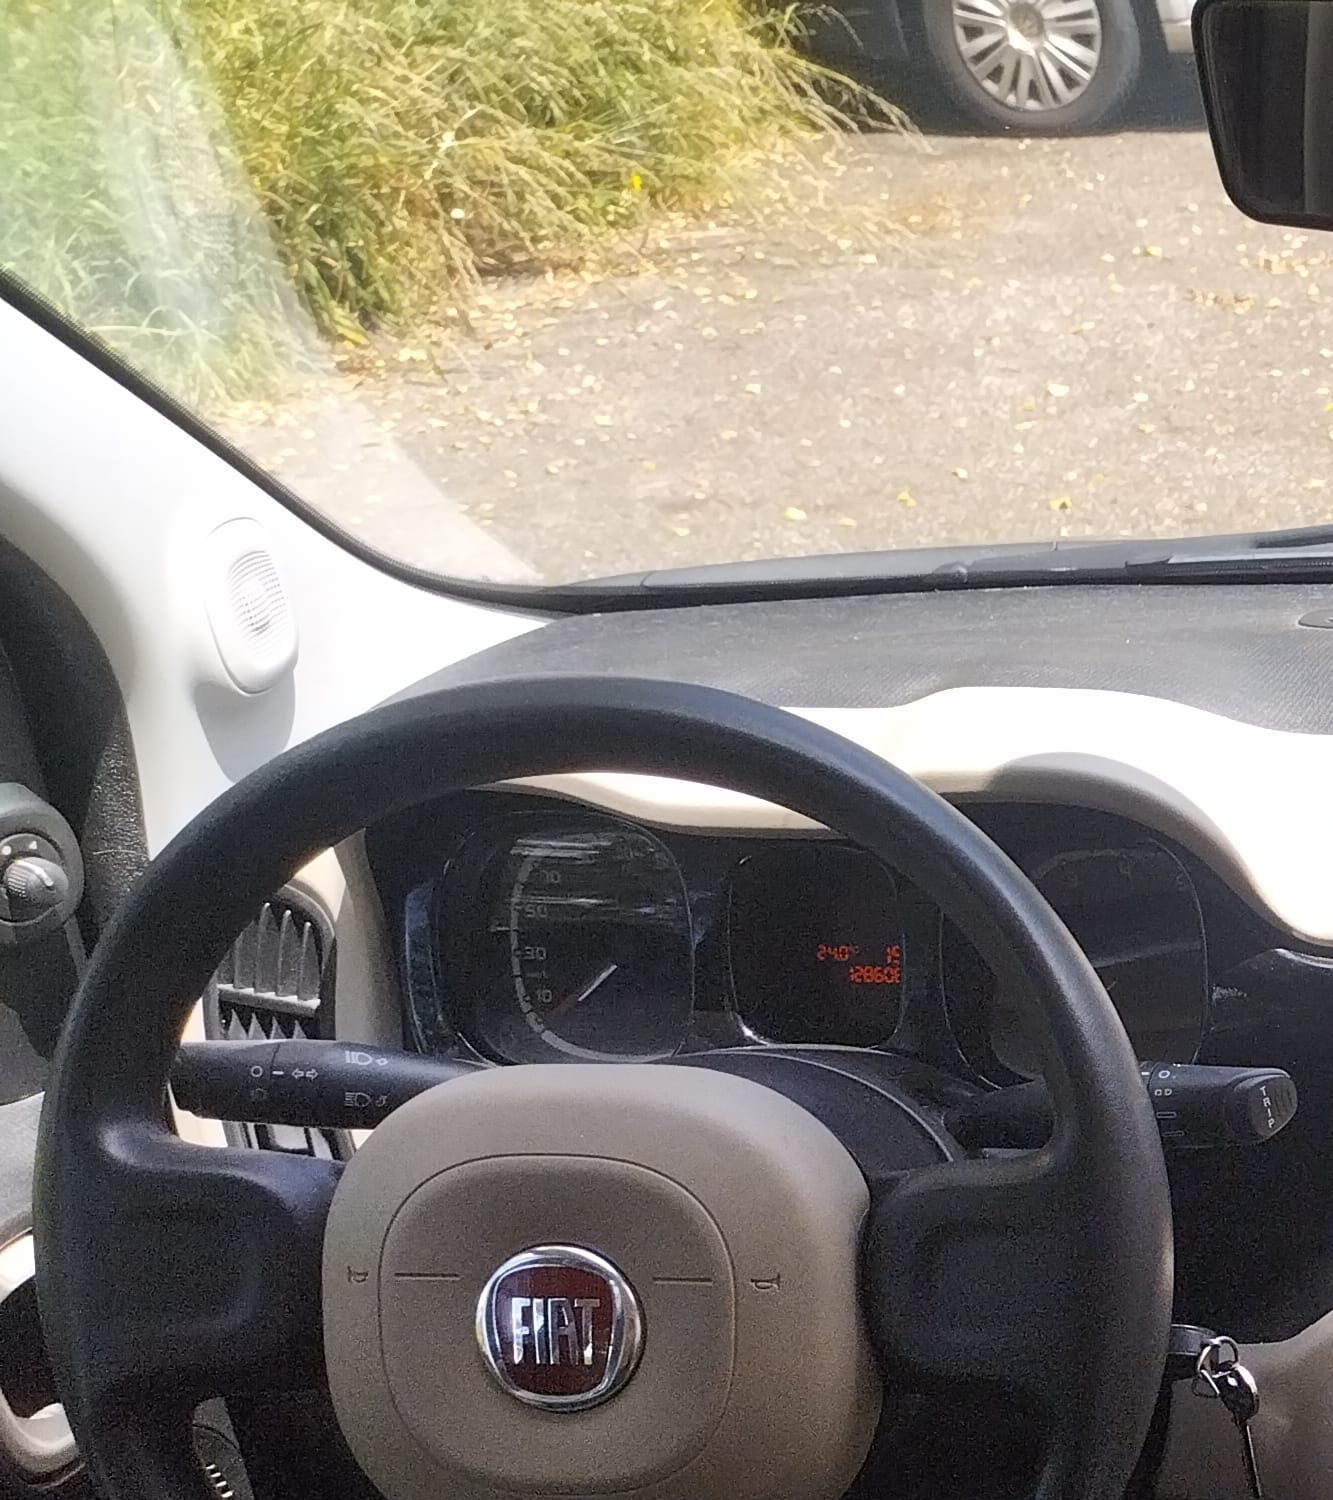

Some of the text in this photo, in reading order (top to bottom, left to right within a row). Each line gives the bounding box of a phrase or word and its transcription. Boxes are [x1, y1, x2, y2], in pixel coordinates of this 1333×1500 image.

[523, 946, 548, 961] 30
[1259, 1085, 1275, 1129] TRIP
[511, 1297, 600, 1365] FIAT
